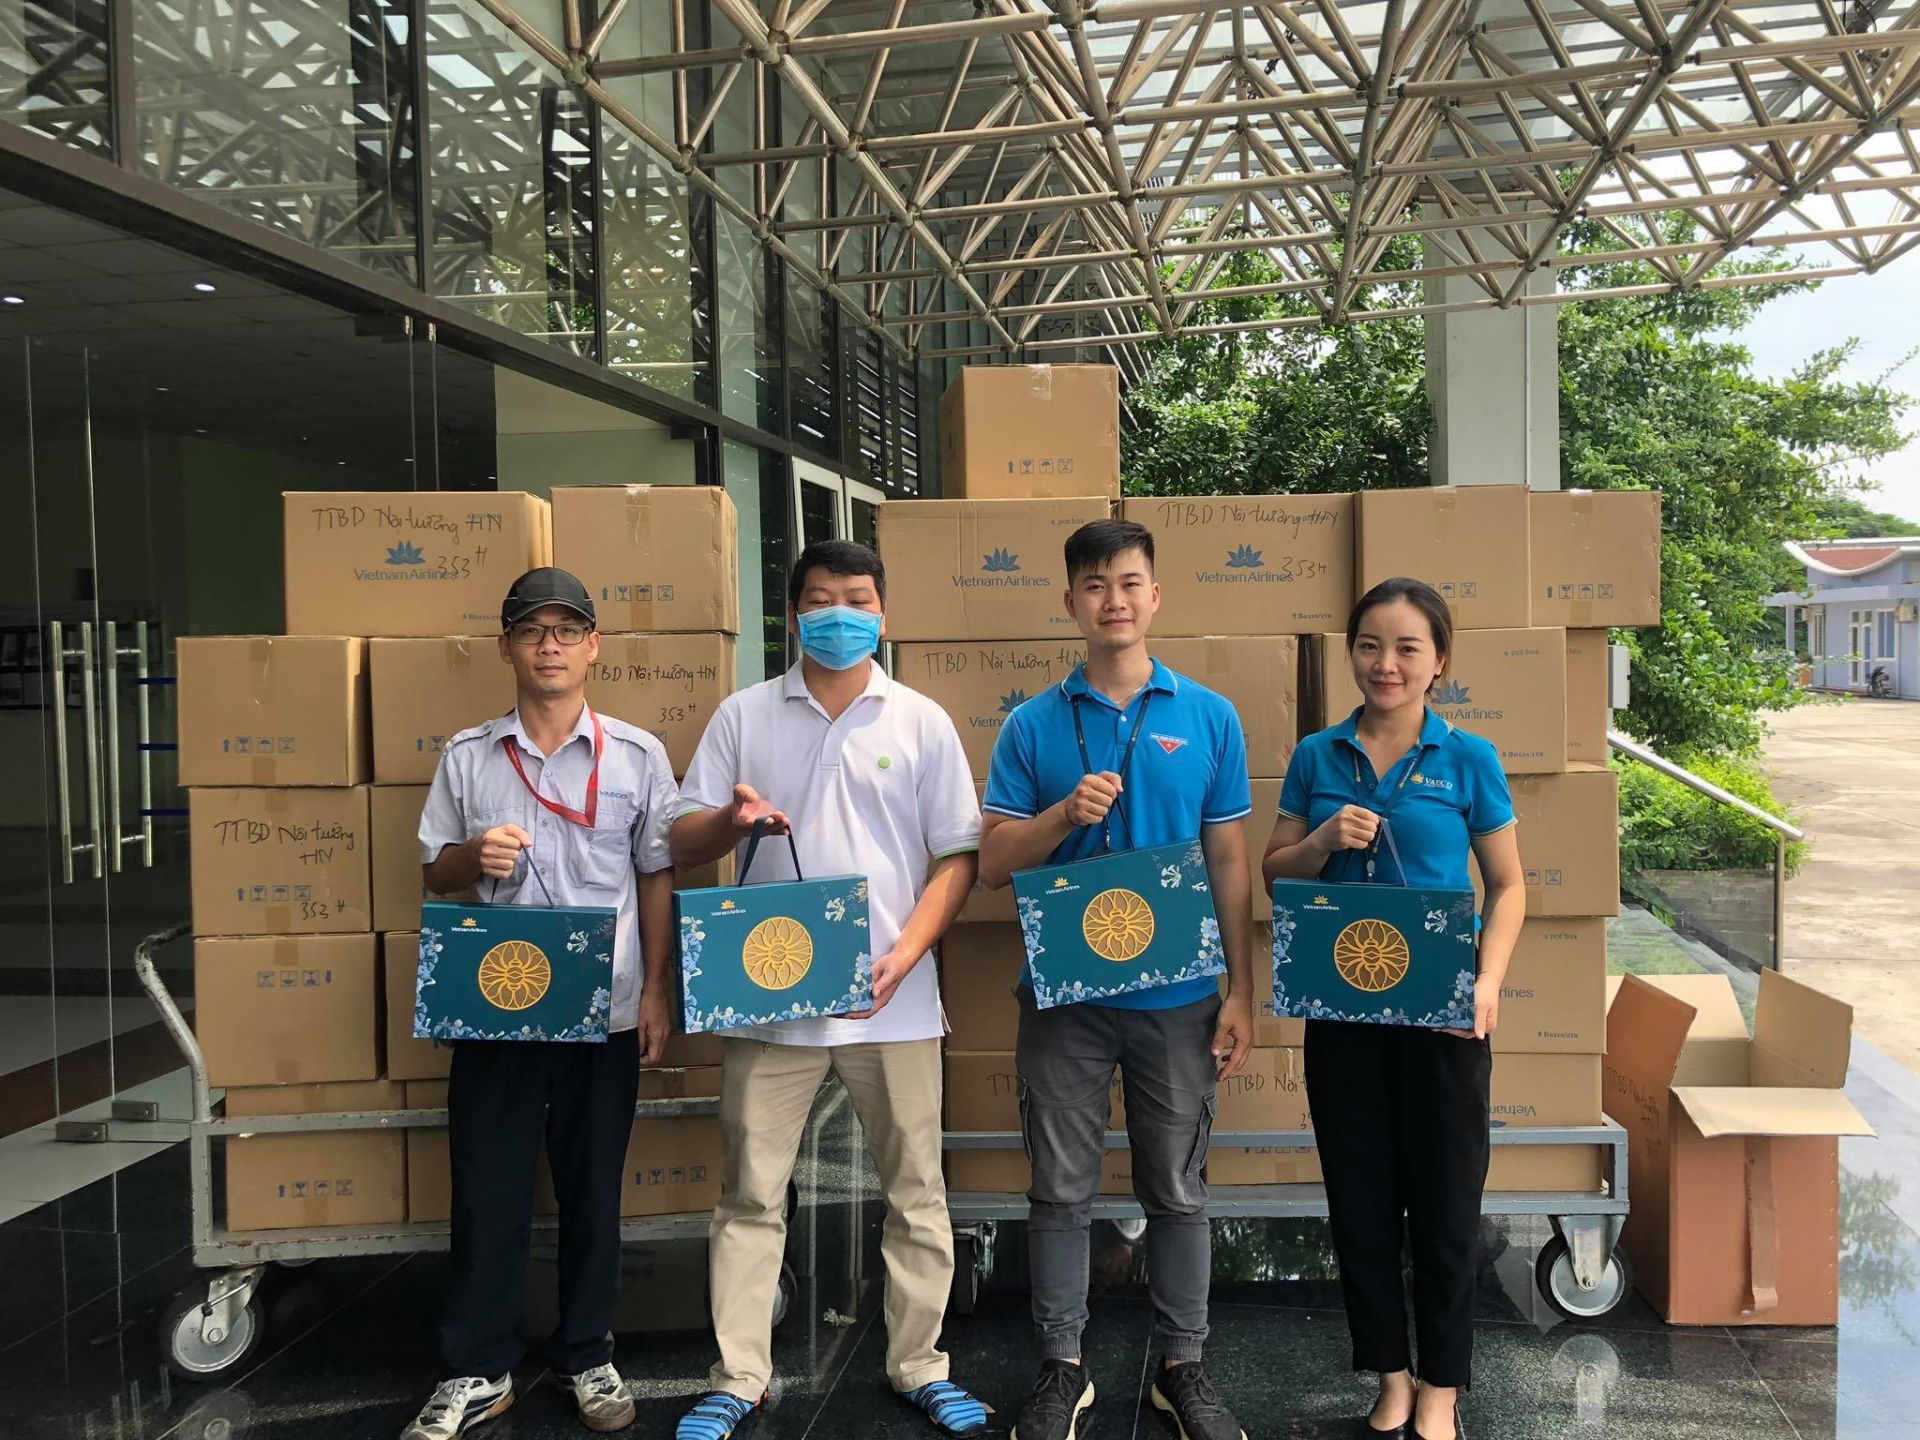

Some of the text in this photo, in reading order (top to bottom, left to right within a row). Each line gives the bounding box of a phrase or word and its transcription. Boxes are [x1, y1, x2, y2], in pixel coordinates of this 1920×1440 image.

[311, 506, 365, 531] TTBD
[1157, 501, 1213, 528] TTBD
[923, 652, 967, 679] TTBD
[599, 790, 628, 799] VAECO
[214, 818, 270, 846] TTBD
[299, 847, 333, 865] HN
